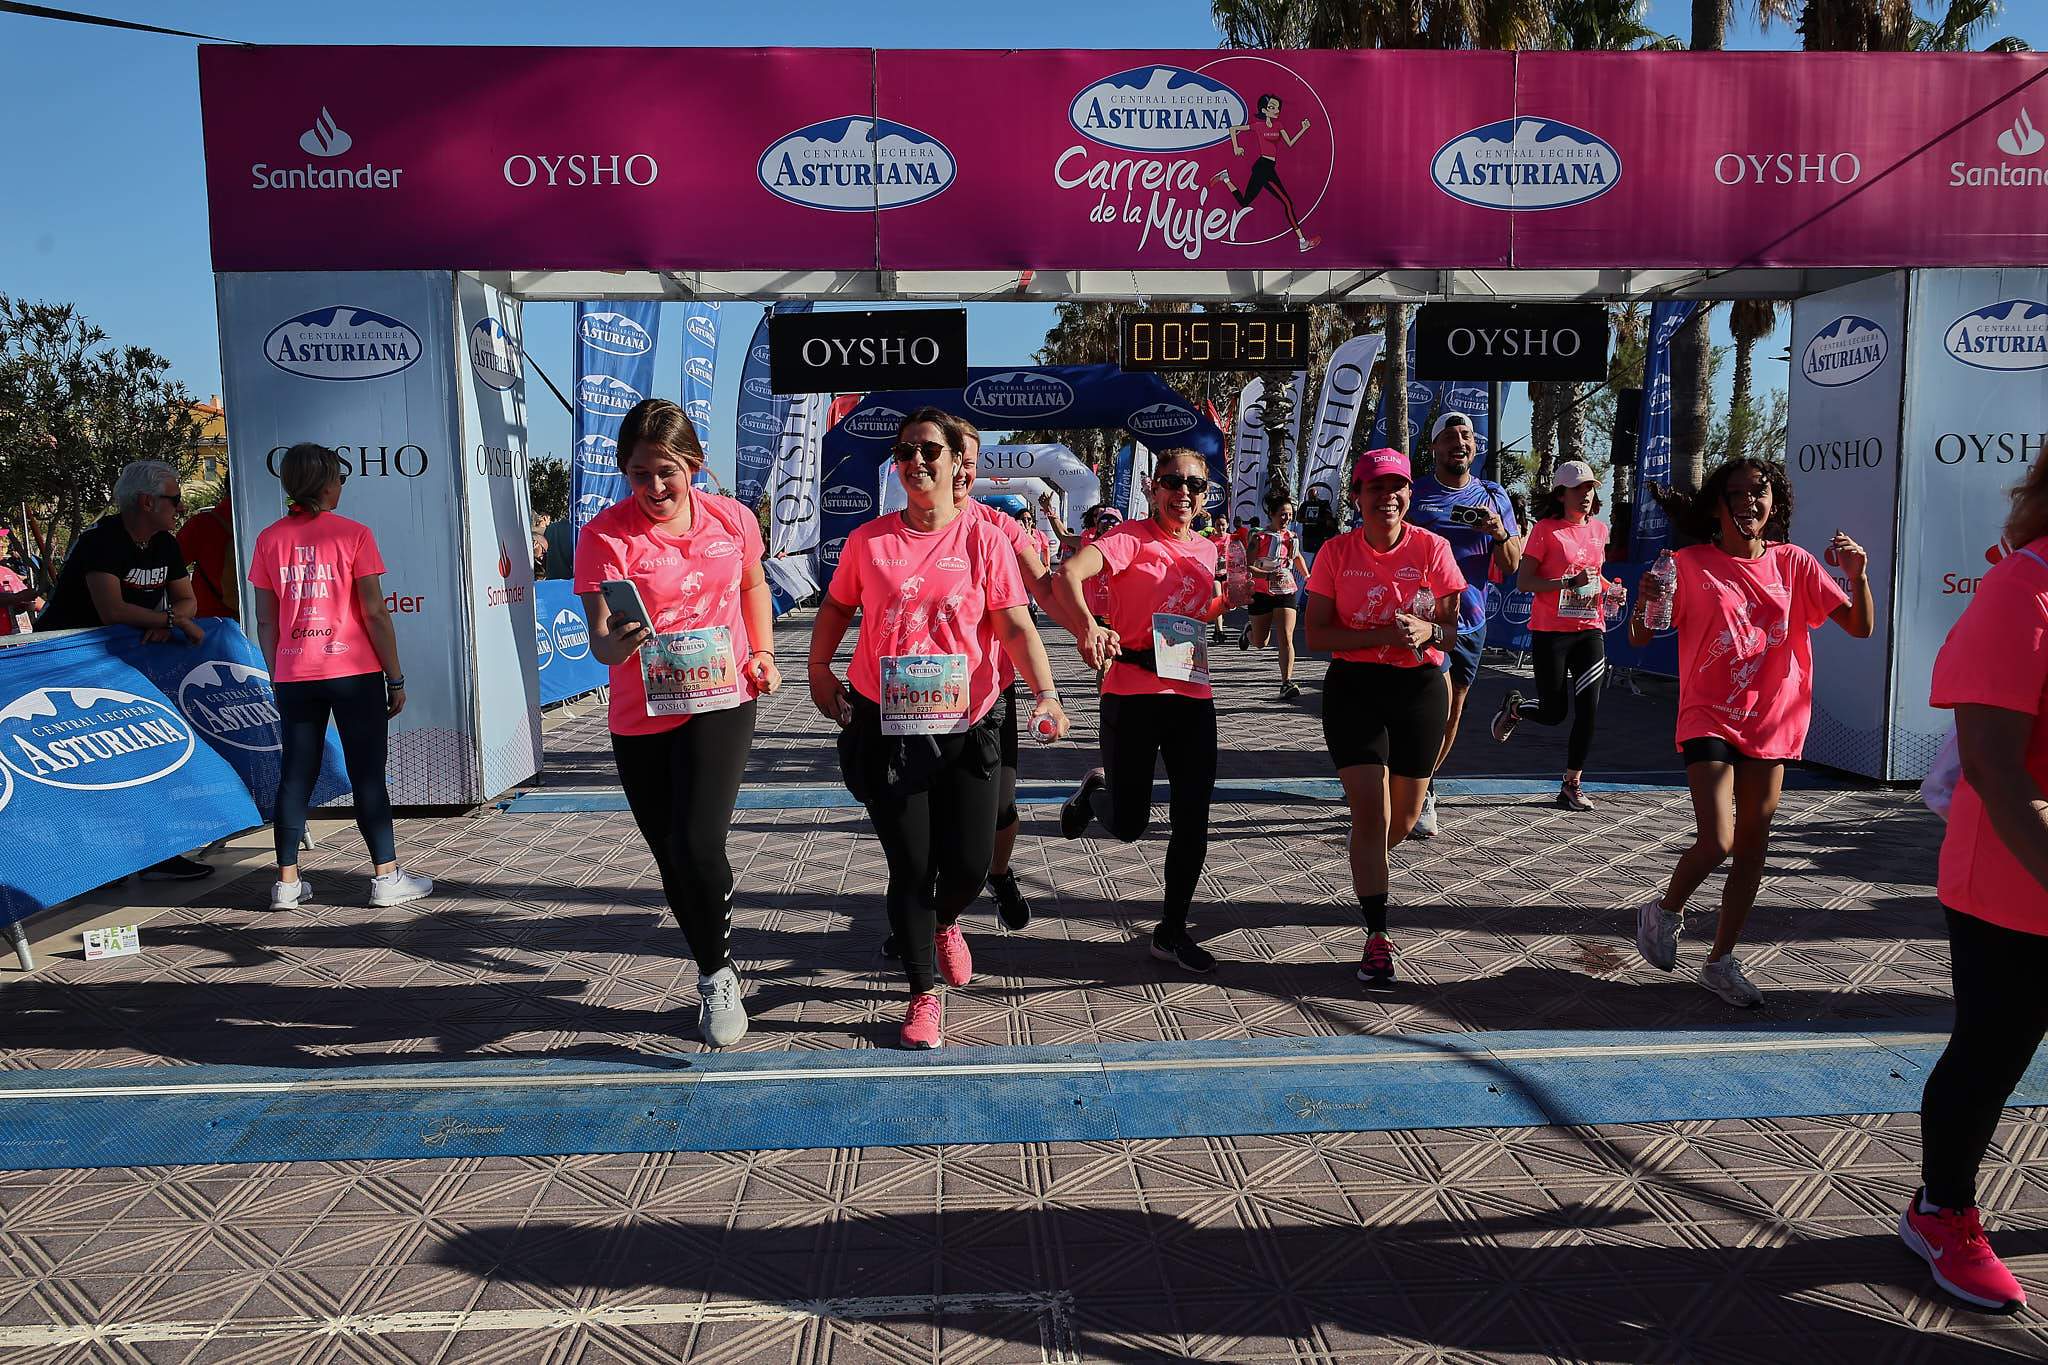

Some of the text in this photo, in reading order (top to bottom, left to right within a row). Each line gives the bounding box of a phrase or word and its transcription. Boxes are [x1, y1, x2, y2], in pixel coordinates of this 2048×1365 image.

[1110, 95, 1229, 104] CENTRAL LECHERA
[1083, 96, 1234, 130] ASTURIANA
[803, 149, 865, 159] CENTRAL
[1475, 149, 1601, 158] CENTRAL LECHERA
[251, 162, 403, 190] Santander
[503, 154, 659, 187] OYSHO
[774, 151, 942, 187] ASTURIANA
[1055, 145, 1201, 191] Carrera
[1445, 151, 1607, 186] ASTURIANA
[1713, 151, 1862, 186] OYSHO
[1089, 186, 1254, 260] de la Mujer
[299, 331, 405, 340] CENTRAL LECHERA
[581, 320, 645, 351] ASTURIANA
[1976, 323, 2023, 332] CENTRAL
[276, 334, 413, 362] ASTURIANA
[801, 337, 941, 367] OYSHO
[1134, 322, 1295, 362] 00:57:34
[1447, 327, 1581, 357] OYSHO
[1806, 343, 1881, 374] ASTURIANA
[971, 386, 1067, 407] ASTURIANA
[1449, 394, 1489, 411] ASTURIAN
[847, 417, 901, 432] ASTURIAN
[1133, 414, 1194, 430] ASTURIANA
[476, 444, 524, 480] OYSHO
[1798, 436, 1884, 473] OYSHO
[1058, 468, 1085, 476] OYSHO
[822, 497, 869, 508] ASTURIANA
[1072, 504, 1090, 512] OYS
[294, 545, 316, 563] TU
[639, 556, 678, 570] OYSHO
[872, 558, 908, 568] OYSHO
[279, 562, 336, 585] DORSAL
[290, 581, 330, 600] SUMA
[487, 585, 525, 607] Santander
[206, 688, 247, 703] CENTRAL
[31, 704, 156, 738] CENTRAL LECHERA
[13, 716, 188, 776] ASTURIANA
